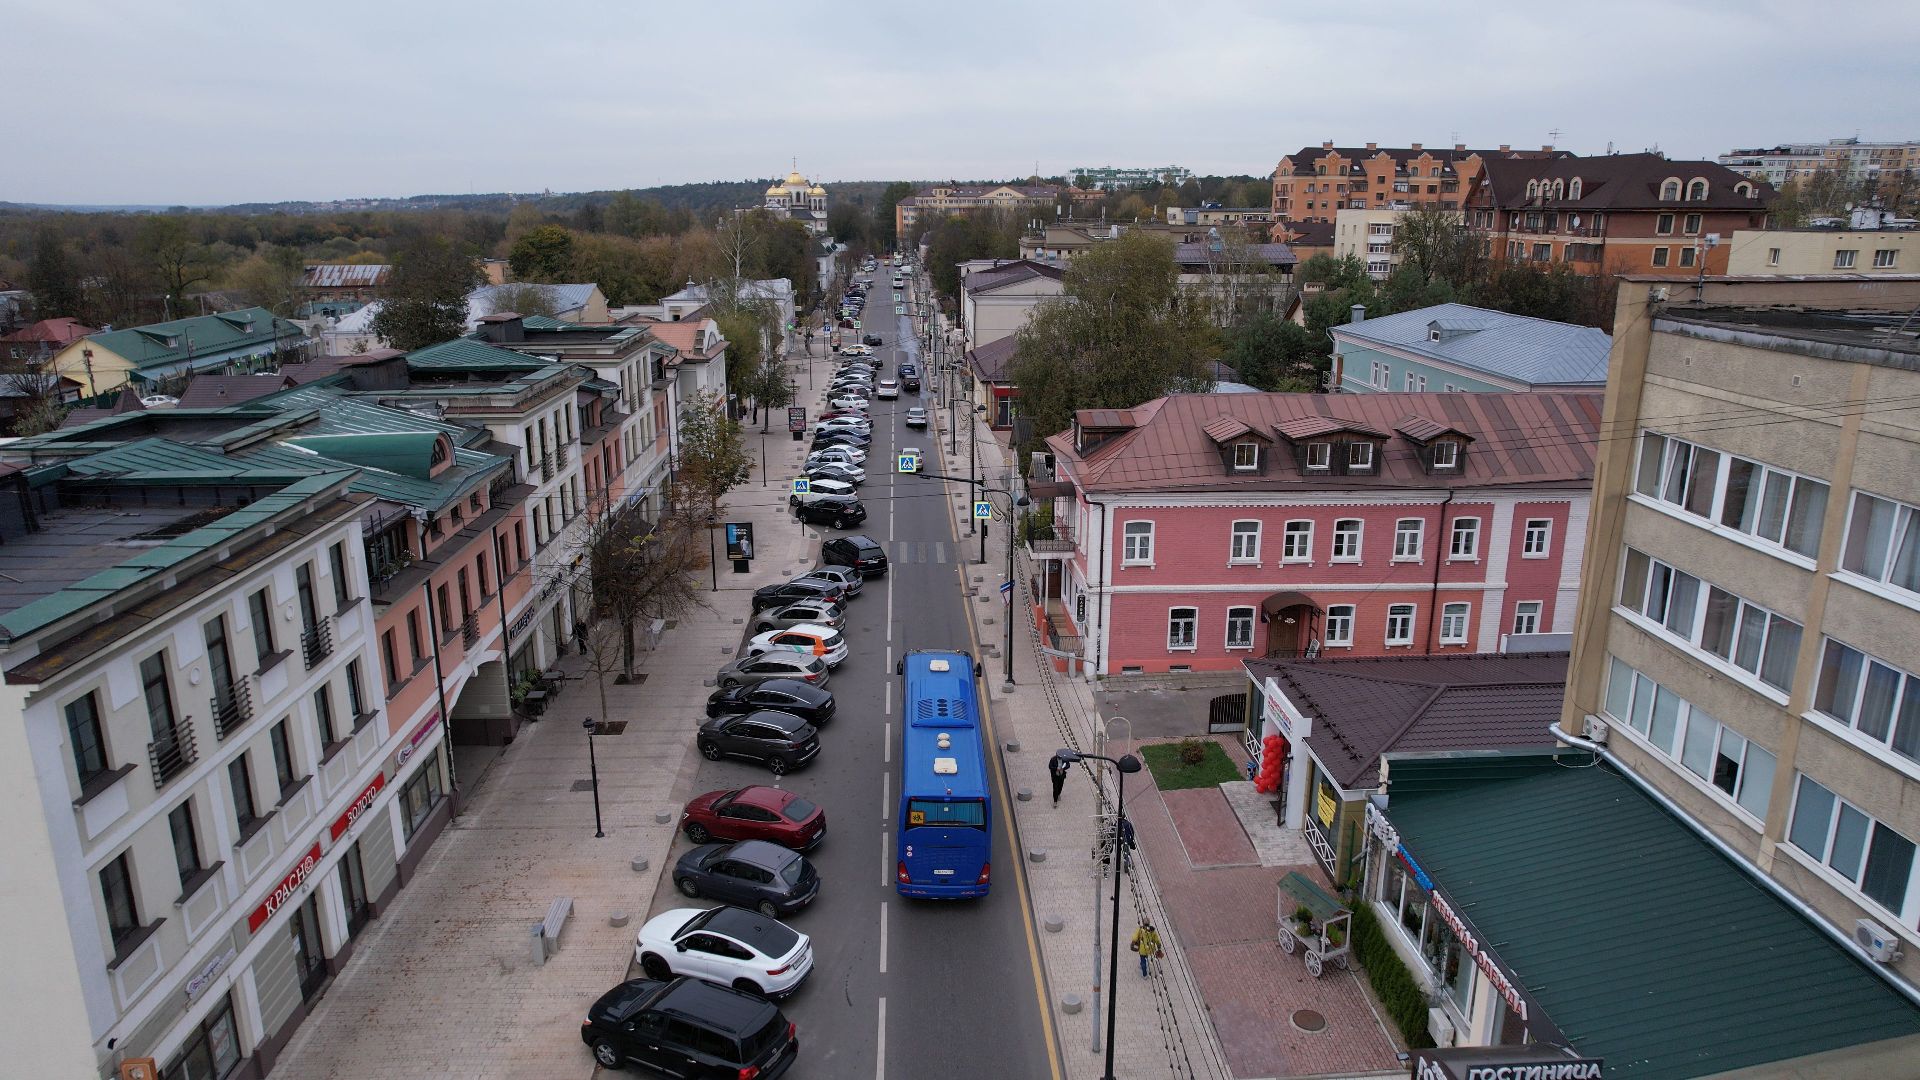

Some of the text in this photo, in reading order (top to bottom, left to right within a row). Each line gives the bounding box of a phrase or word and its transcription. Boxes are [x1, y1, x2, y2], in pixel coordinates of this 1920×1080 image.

[347, 786, 376, 825] ЗОЛОТО
[1431, 889, 1528, 1020] ЖЕНСКАЯ ОДЕЖДА
[1469, 1063, 1602, 1080] ГОСТИНИЦА
